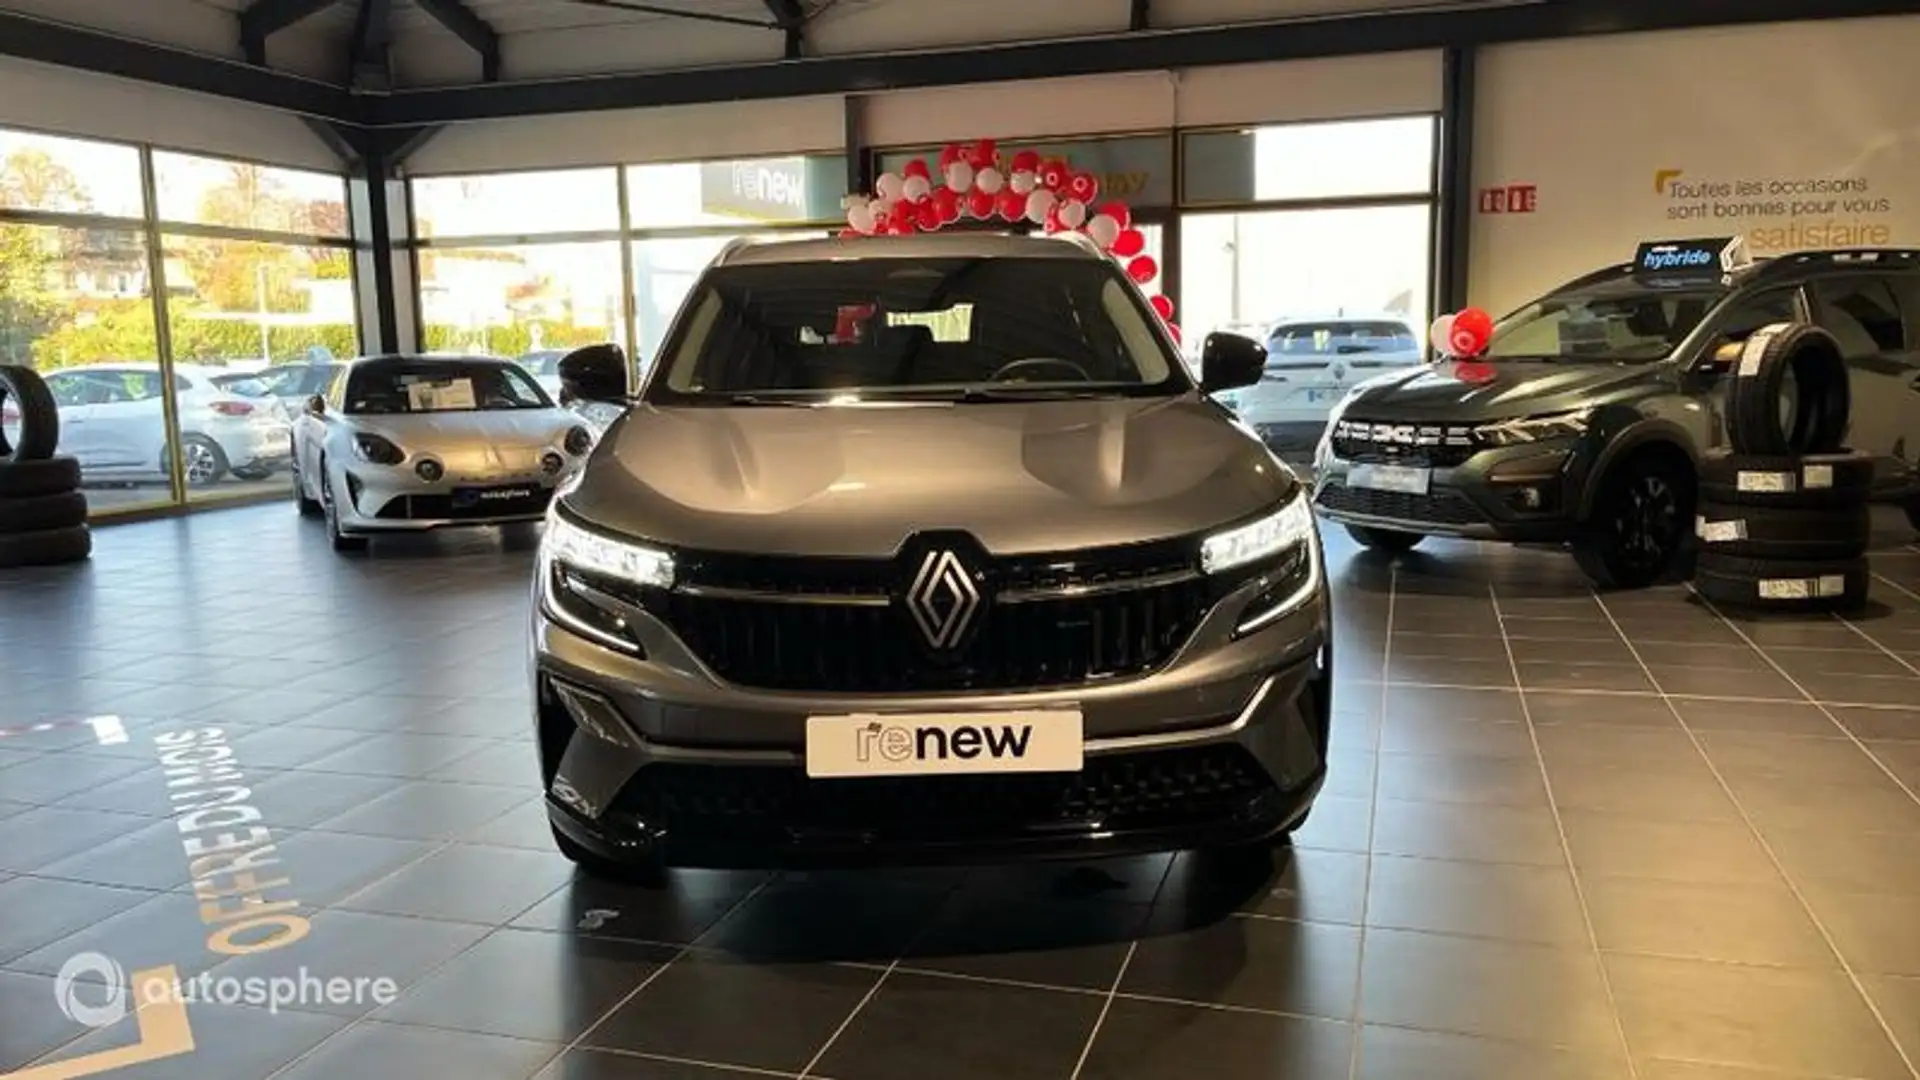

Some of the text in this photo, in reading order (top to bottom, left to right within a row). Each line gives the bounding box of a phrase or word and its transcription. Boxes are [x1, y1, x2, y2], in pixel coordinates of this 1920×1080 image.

[1671, 178, 1868, 198] Toutes les occasions
[1667, 198, 1890, 219] sont bonnes pour vous
[1750, 219, 1890, 249] satisfaire
[1643, 249, 1712, 270] hybride
[856, 722, 1033, 762] renew
